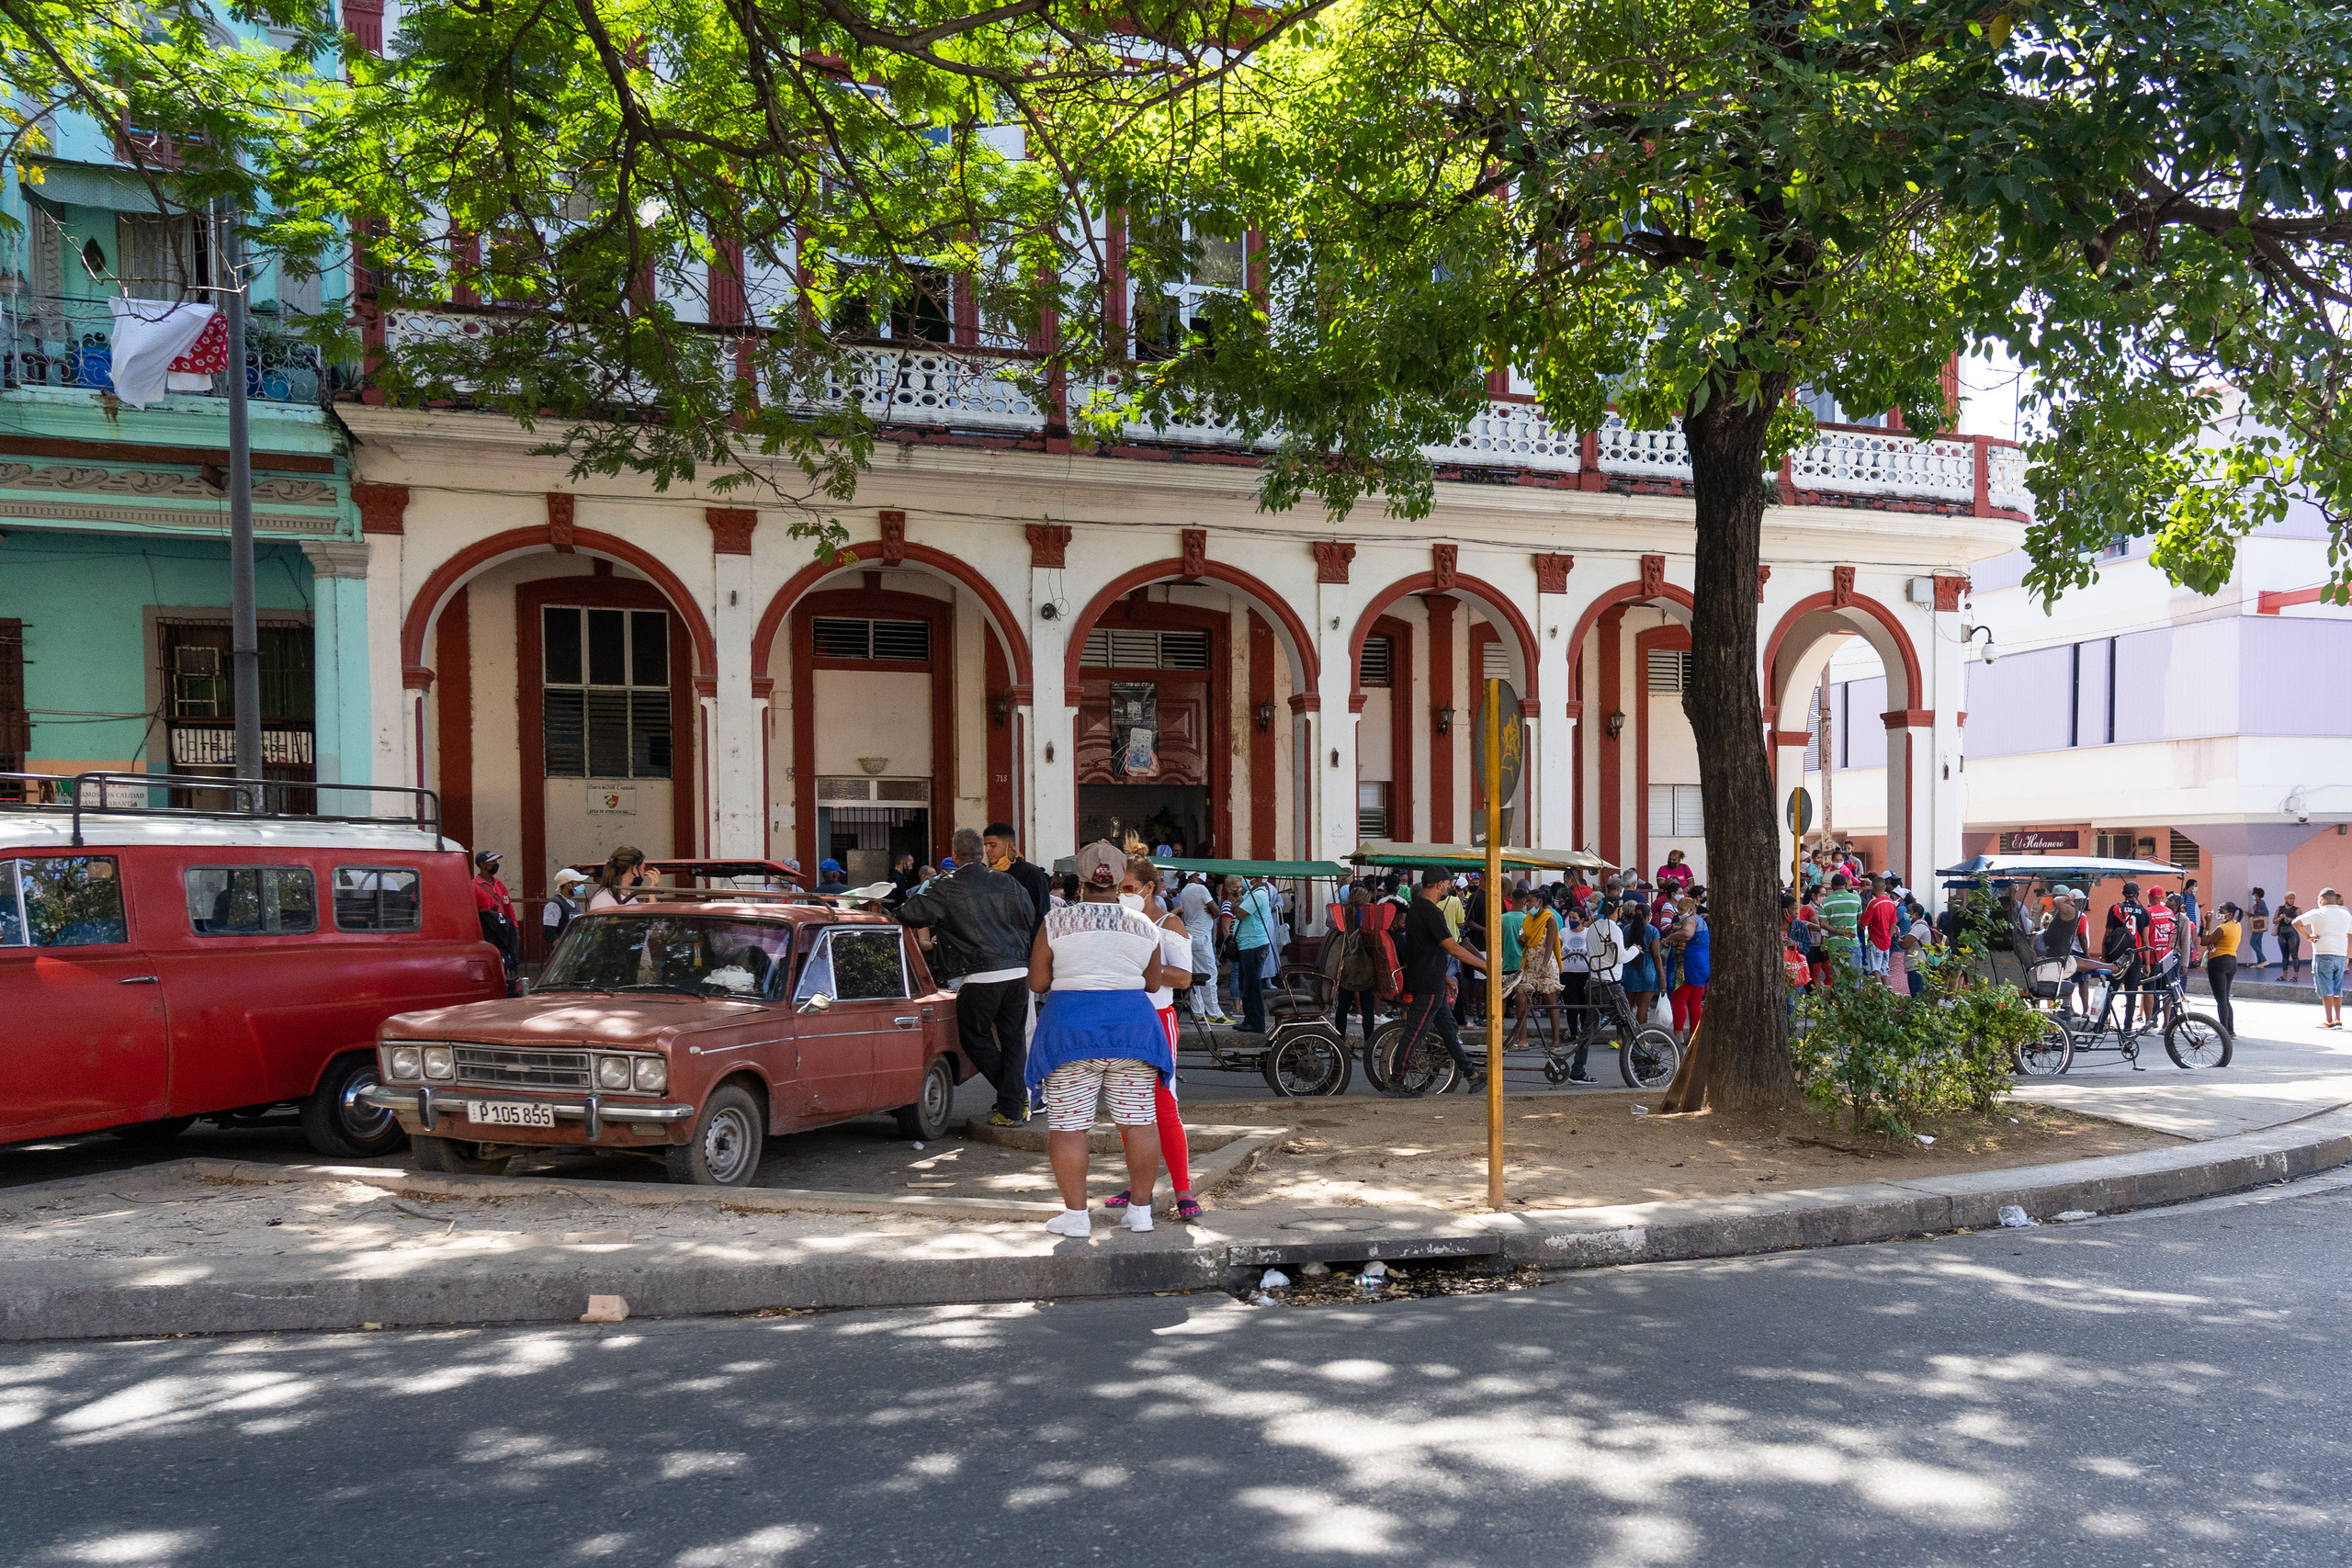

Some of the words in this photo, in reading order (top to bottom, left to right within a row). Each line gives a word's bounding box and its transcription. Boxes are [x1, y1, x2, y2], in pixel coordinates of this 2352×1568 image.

[995, 774, 1008, 783] 713
[2011, 833, 2023, 849] El
[2023, 833, 2064, 849] Habanero
[2125, 915, 2137, 935] 9
[480, 1104, 489, 1122] P
[492, 1105, 520, 1123] 105
[523, 1107, 551, 1125] 855
